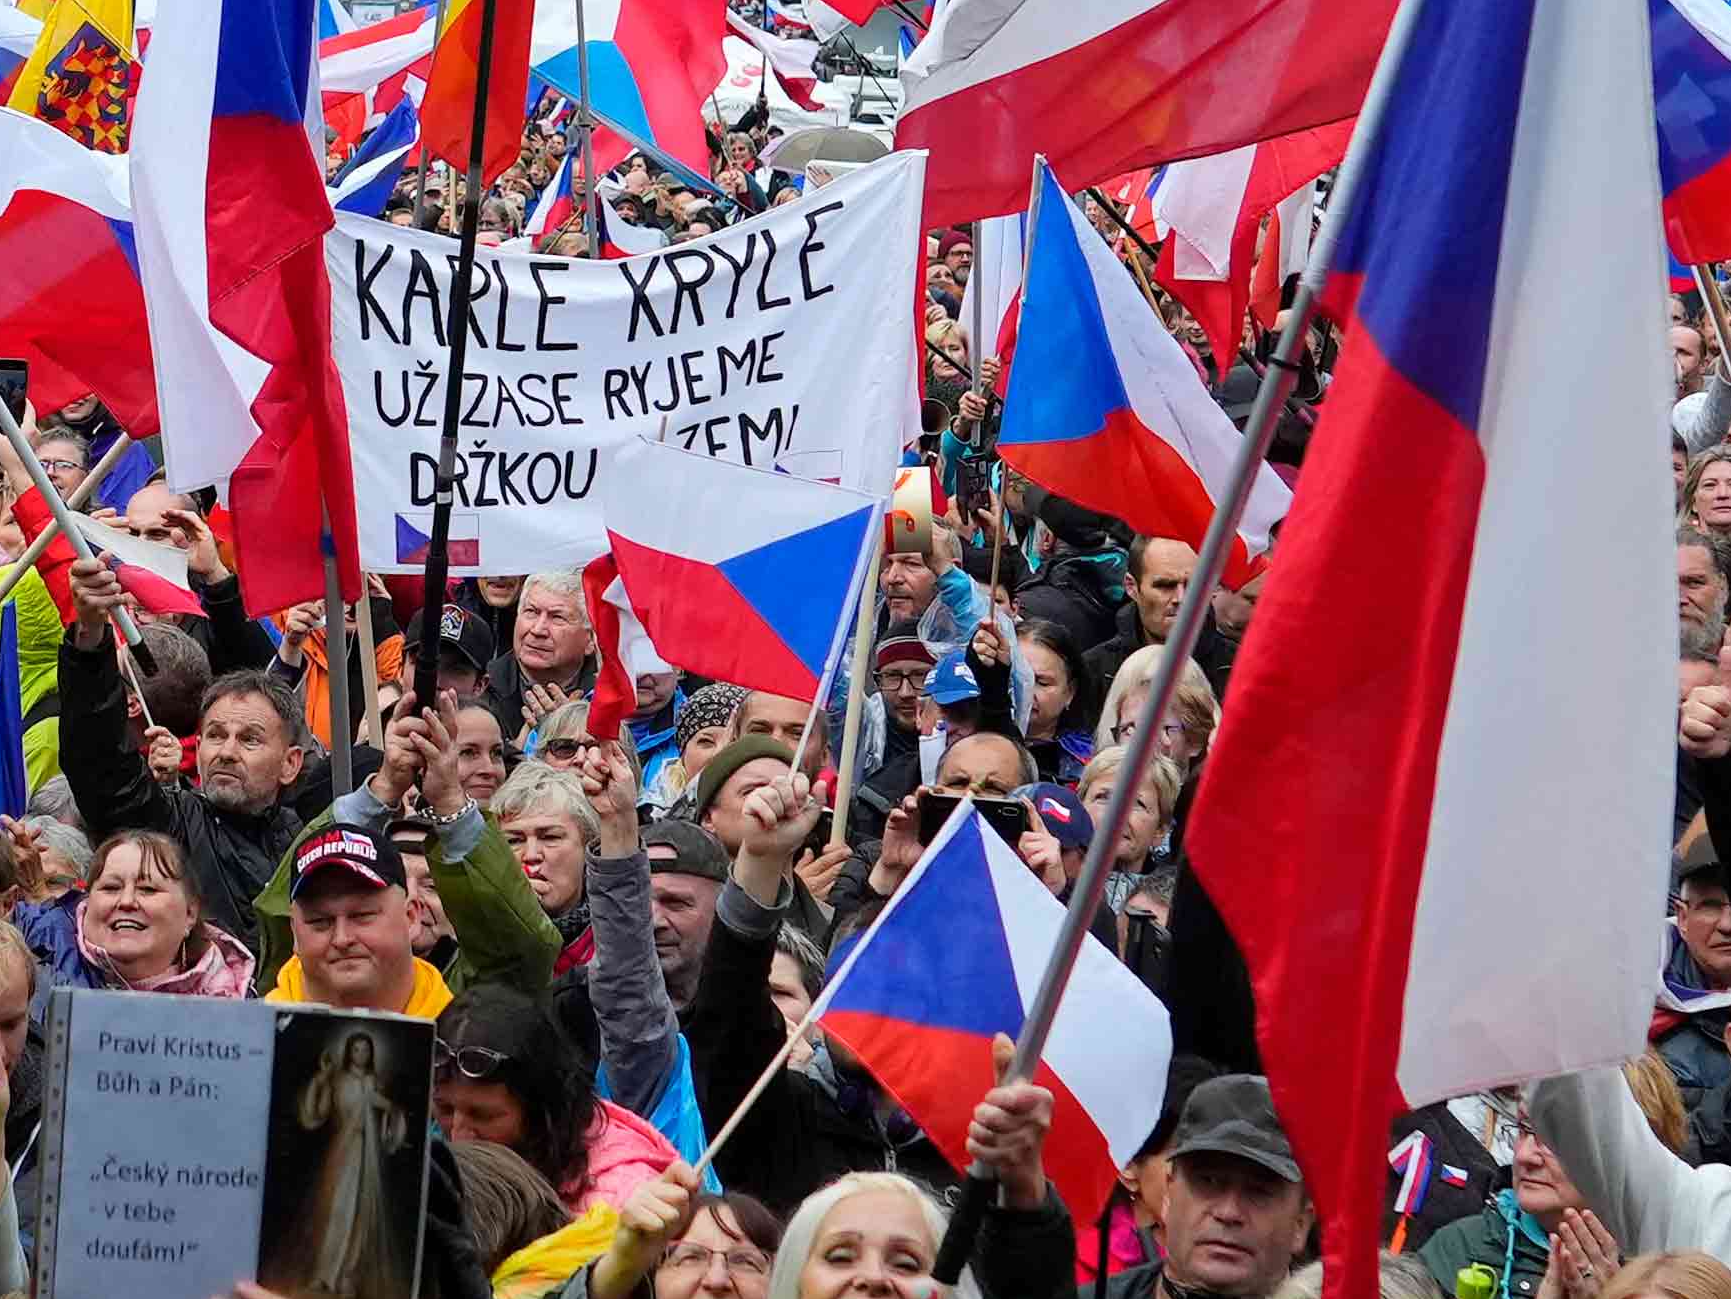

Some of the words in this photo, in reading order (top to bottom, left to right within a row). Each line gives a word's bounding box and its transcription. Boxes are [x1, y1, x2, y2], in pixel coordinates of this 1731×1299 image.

[353, 238, 578, 352] KARLE
[373, 360, 440, 429] UŽ
[459, 370, 585, 429] ZASE
[603, 328, 786, 422] RYJEME
[410, 439, 599, 508] DRŽKOU
[322, 831, 377, 862] REPUBLIC
[98, 1030, 155, 1058] Praví
[164, 1035, 242, 1061] Kristus
[96, 1069, 141, 1096] Bůh
[148, 1081, 161, 1097] a
[169, 1073, 220, 1101] Pán:
[176, 1163, 260, 1189] národe
[104, 1202, 115, 1221] v
[122, 1200, 177, 1224] tebe
